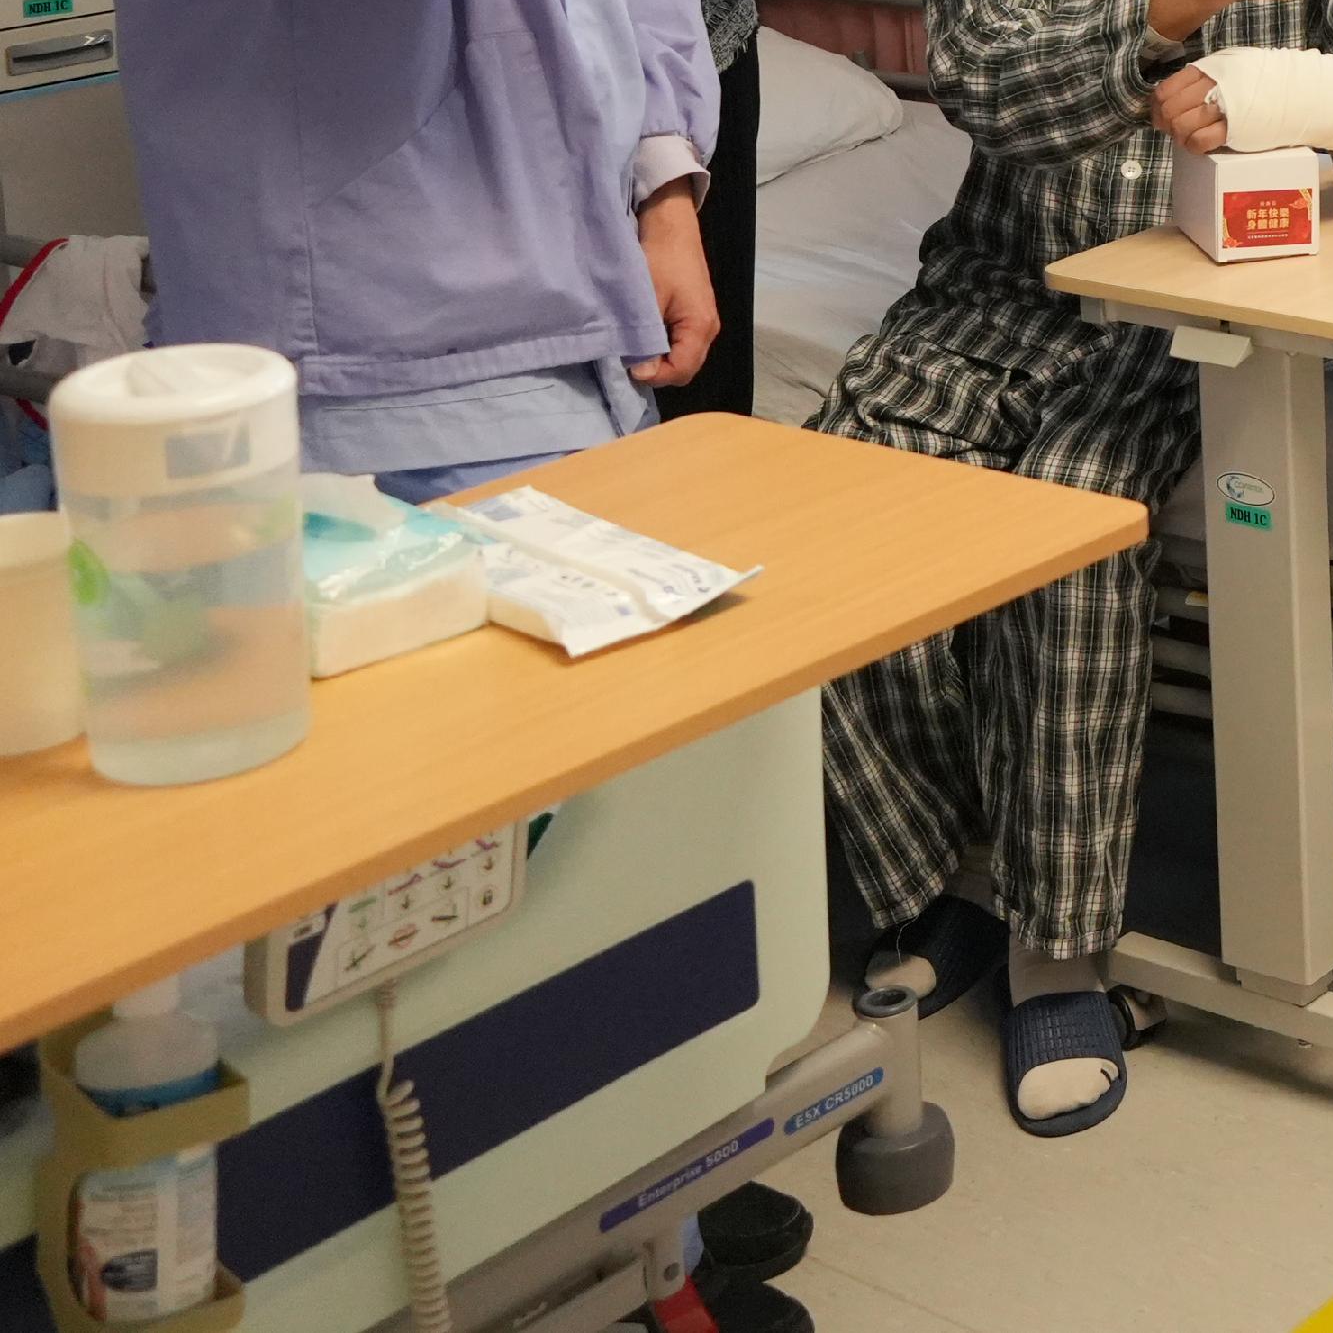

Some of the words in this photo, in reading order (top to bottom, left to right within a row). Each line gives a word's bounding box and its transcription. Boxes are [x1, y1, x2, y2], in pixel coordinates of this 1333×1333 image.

[29, 1, 52, 14] NDH
[1229, 506, 1251, 523] NDH
[1254, 512, 1267, 526] 1C
[637, 1165, 702, 1209] Enterprise
[704, 1139, 739, 1168] 5000
